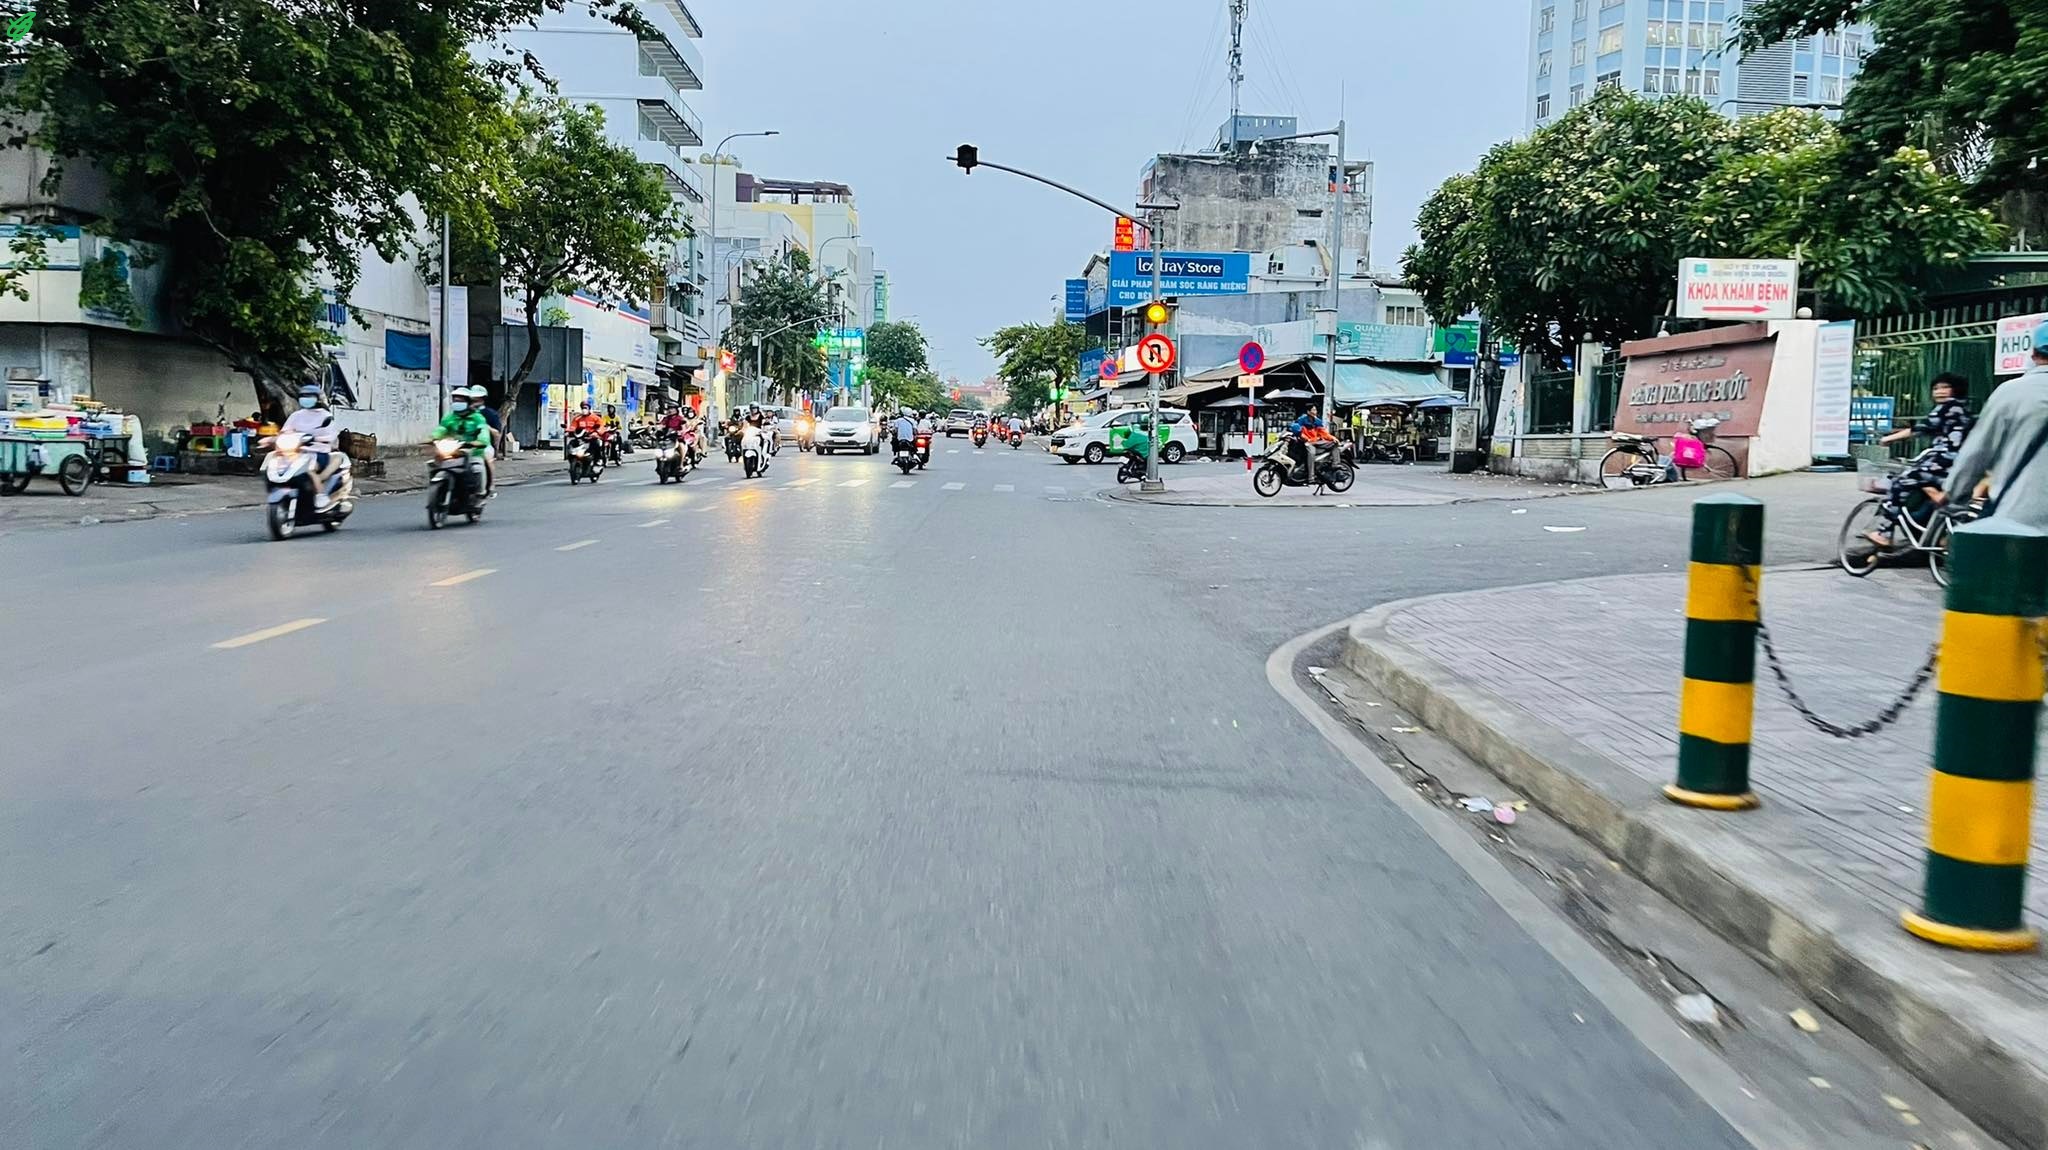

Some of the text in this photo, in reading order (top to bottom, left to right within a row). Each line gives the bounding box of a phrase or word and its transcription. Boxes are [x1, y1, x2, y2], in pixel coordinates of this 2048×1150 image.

[1187, 261, 1222, 274] Store
[1178, 280, 1196, 290] SÓC
[1220, 280, 1247, 293] MIỆNG
[1687, 279, 1789, 305] KHOA KHÁM BỆNH
[1119, 291, 1136, 300] CHO
[2000, 330, 2032, 354] KHÔ
